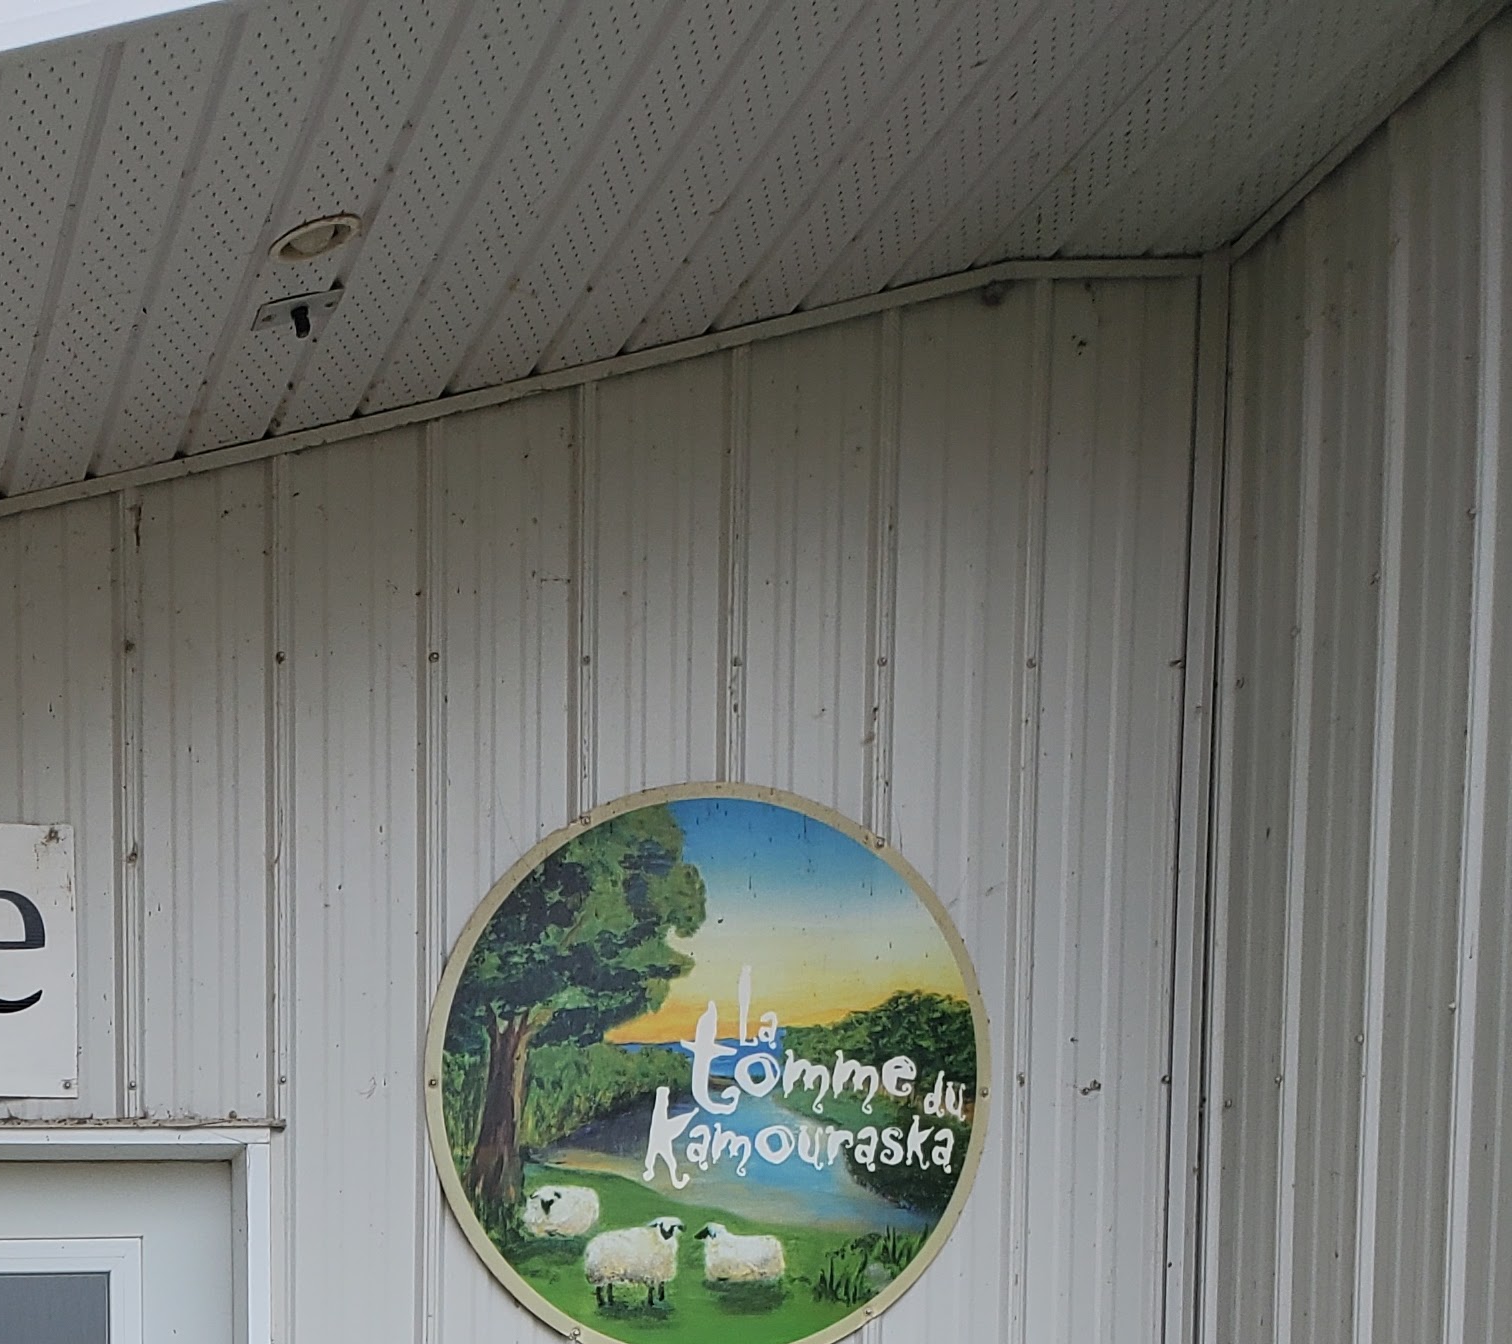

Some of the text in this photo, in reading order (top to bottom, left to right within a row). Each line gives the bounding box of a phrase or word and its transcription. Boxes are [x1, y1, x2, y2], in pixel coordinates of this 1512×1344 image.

[740, 965, 778, 1049] La
[681, 1001, 966, 1122] tomme du
[643, 1087, 955, 1190] Kamouraska
